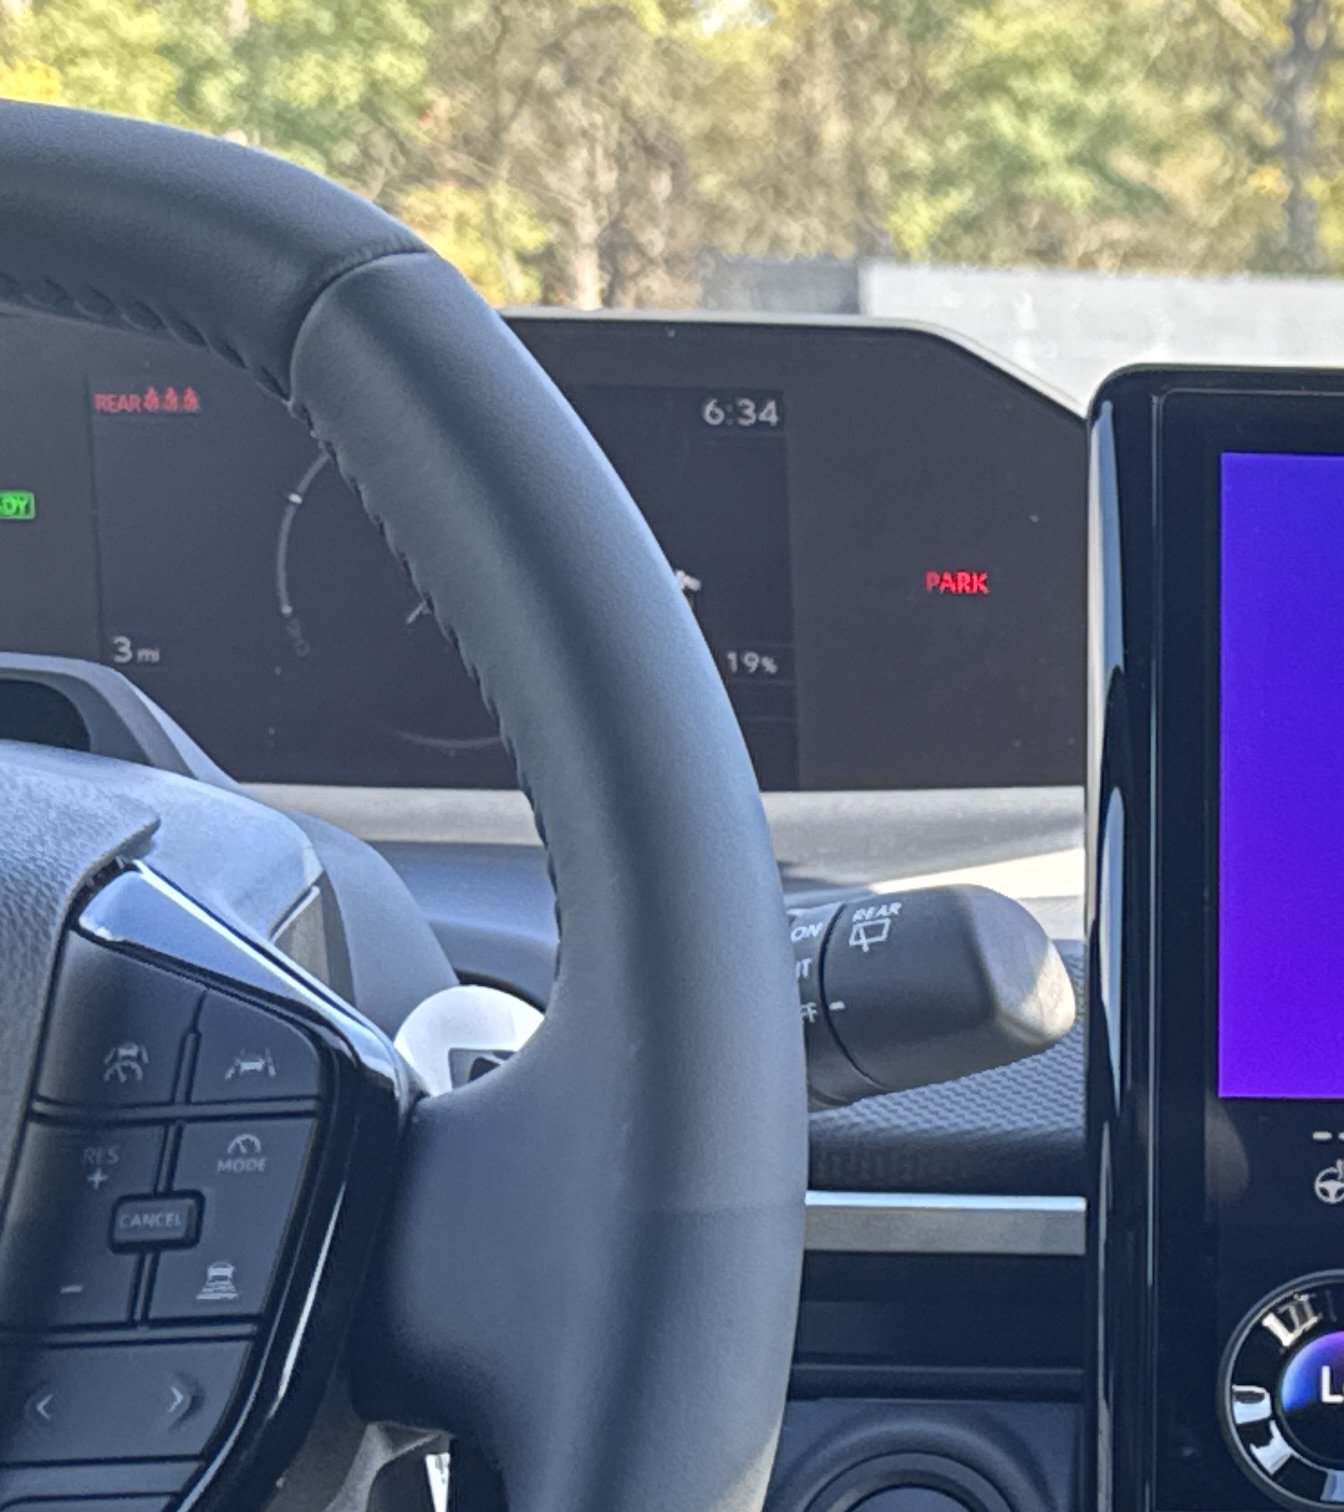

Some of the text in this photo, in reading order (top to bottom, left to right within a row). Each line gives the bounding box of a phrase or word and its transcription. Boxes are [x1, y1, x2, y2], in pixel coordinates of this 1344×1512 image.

[94, 392, 141, 413] REAR
[703, 398, 778, 427] 6:34
[925, 570, 989, 594] PARK
[113, 635, 133, 663] 3
[853, 902, 902, 922] REAR
[790, 922, 823, 942] ON
[84, 1146, 120, 1165] RES
[217, 1156, 267, 1173] MODE
[119, 1211, 182, 1229] CANCEL
